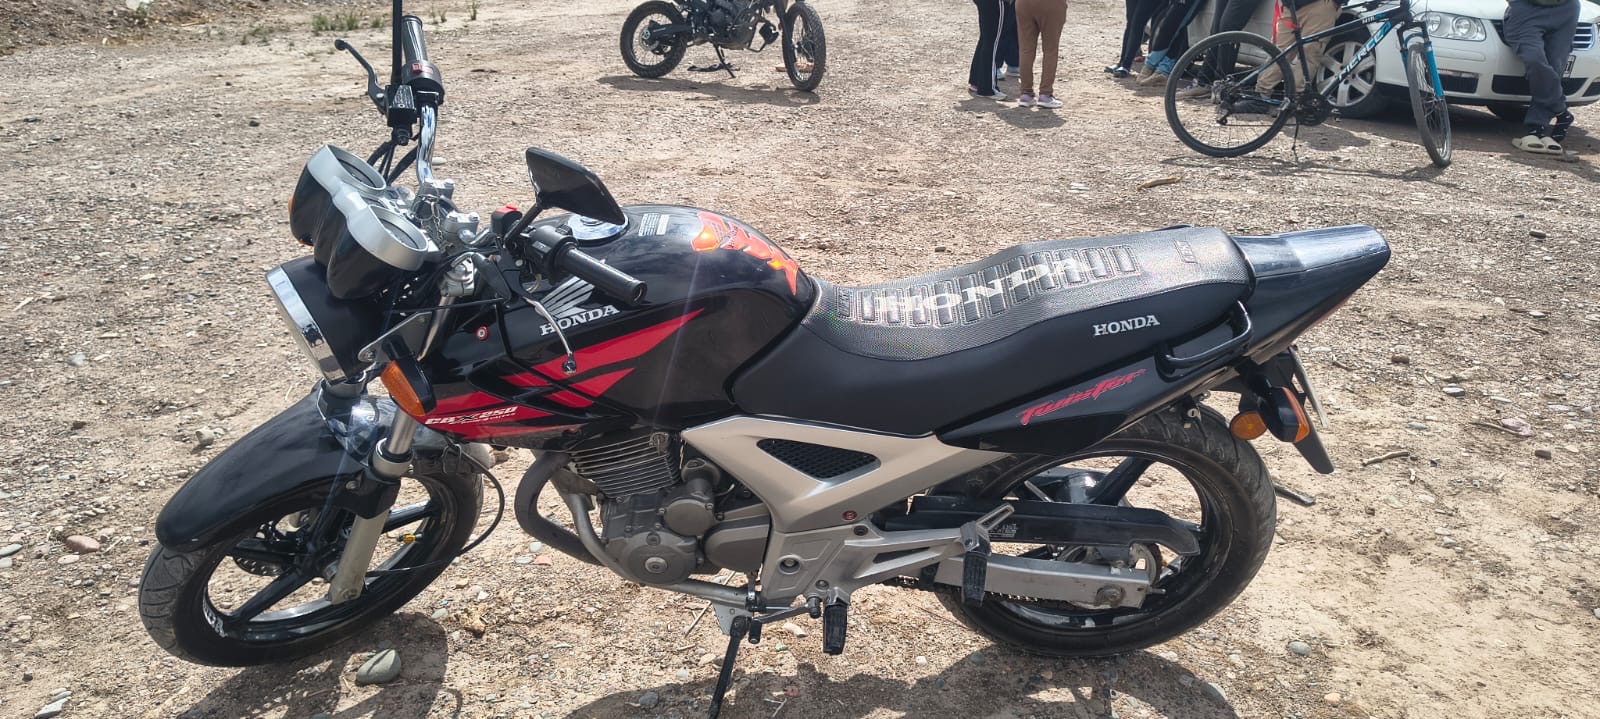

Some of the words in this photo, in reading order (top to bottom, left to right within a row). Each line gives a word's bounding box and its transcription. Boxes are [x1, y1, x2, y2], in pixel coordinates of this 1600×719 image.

[874, 256, 1103, 313] HONDA
[539, 305, 620, 336] HONDA
[1093, 314, 1160, 336] HONDA
